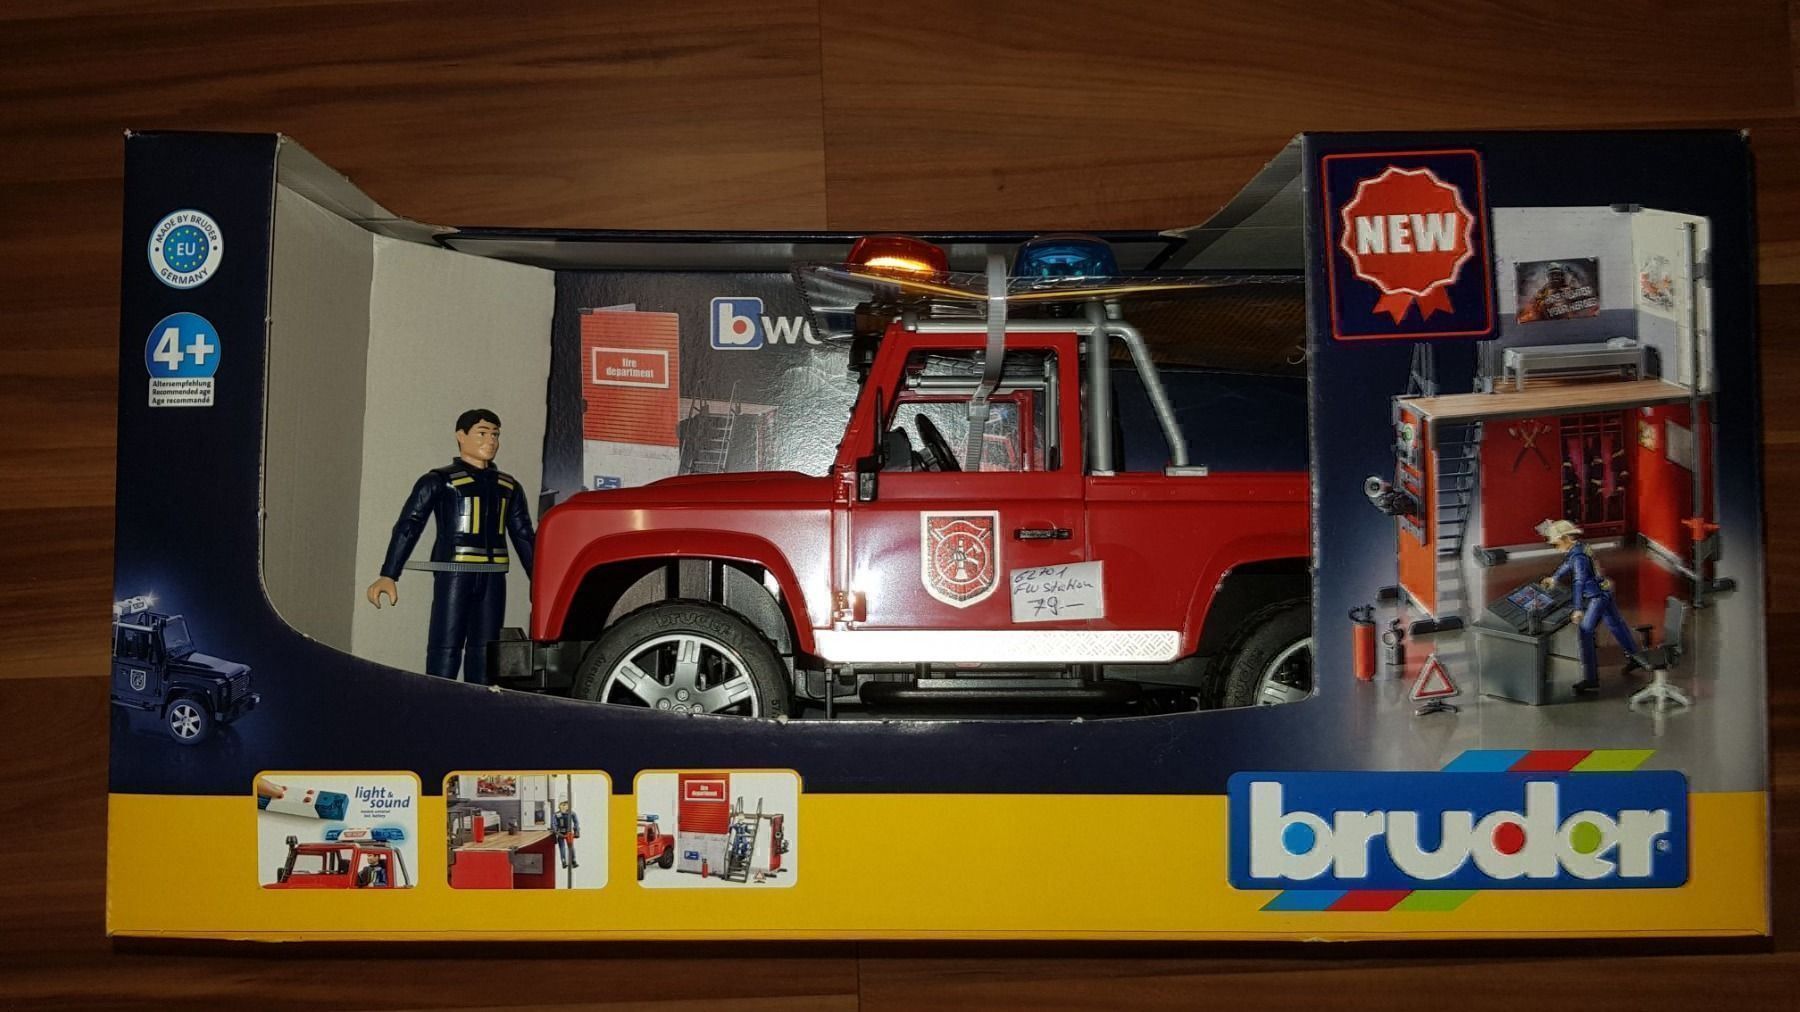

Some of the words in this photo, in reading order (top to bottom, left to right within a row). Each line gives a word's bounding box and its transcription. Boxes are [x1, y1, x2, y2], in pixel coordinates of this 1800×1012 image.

[156, 218, 177, 243] MADE
[177, 215, 189, 223] BY
[190, 215, 217, 241] BRUDER
[1355, 212, 1457, 255] NEW
[177, 242, 196, 256] EU
[161, 268, 208, 284] GERMANY
[153, 327, 214, 370] 4+
[622, 358, 637, 368] fire
[606, 367, 654, 378] department
[152, 380, 212, 388] Altersempfehlung
[152, 397, 165, 405] Age
[596, 478, 604, 488] P
[355, 786, 386, 802] light
[370, 796, 411, 808] sound
[1249, 781, 1669, 880] bruder
